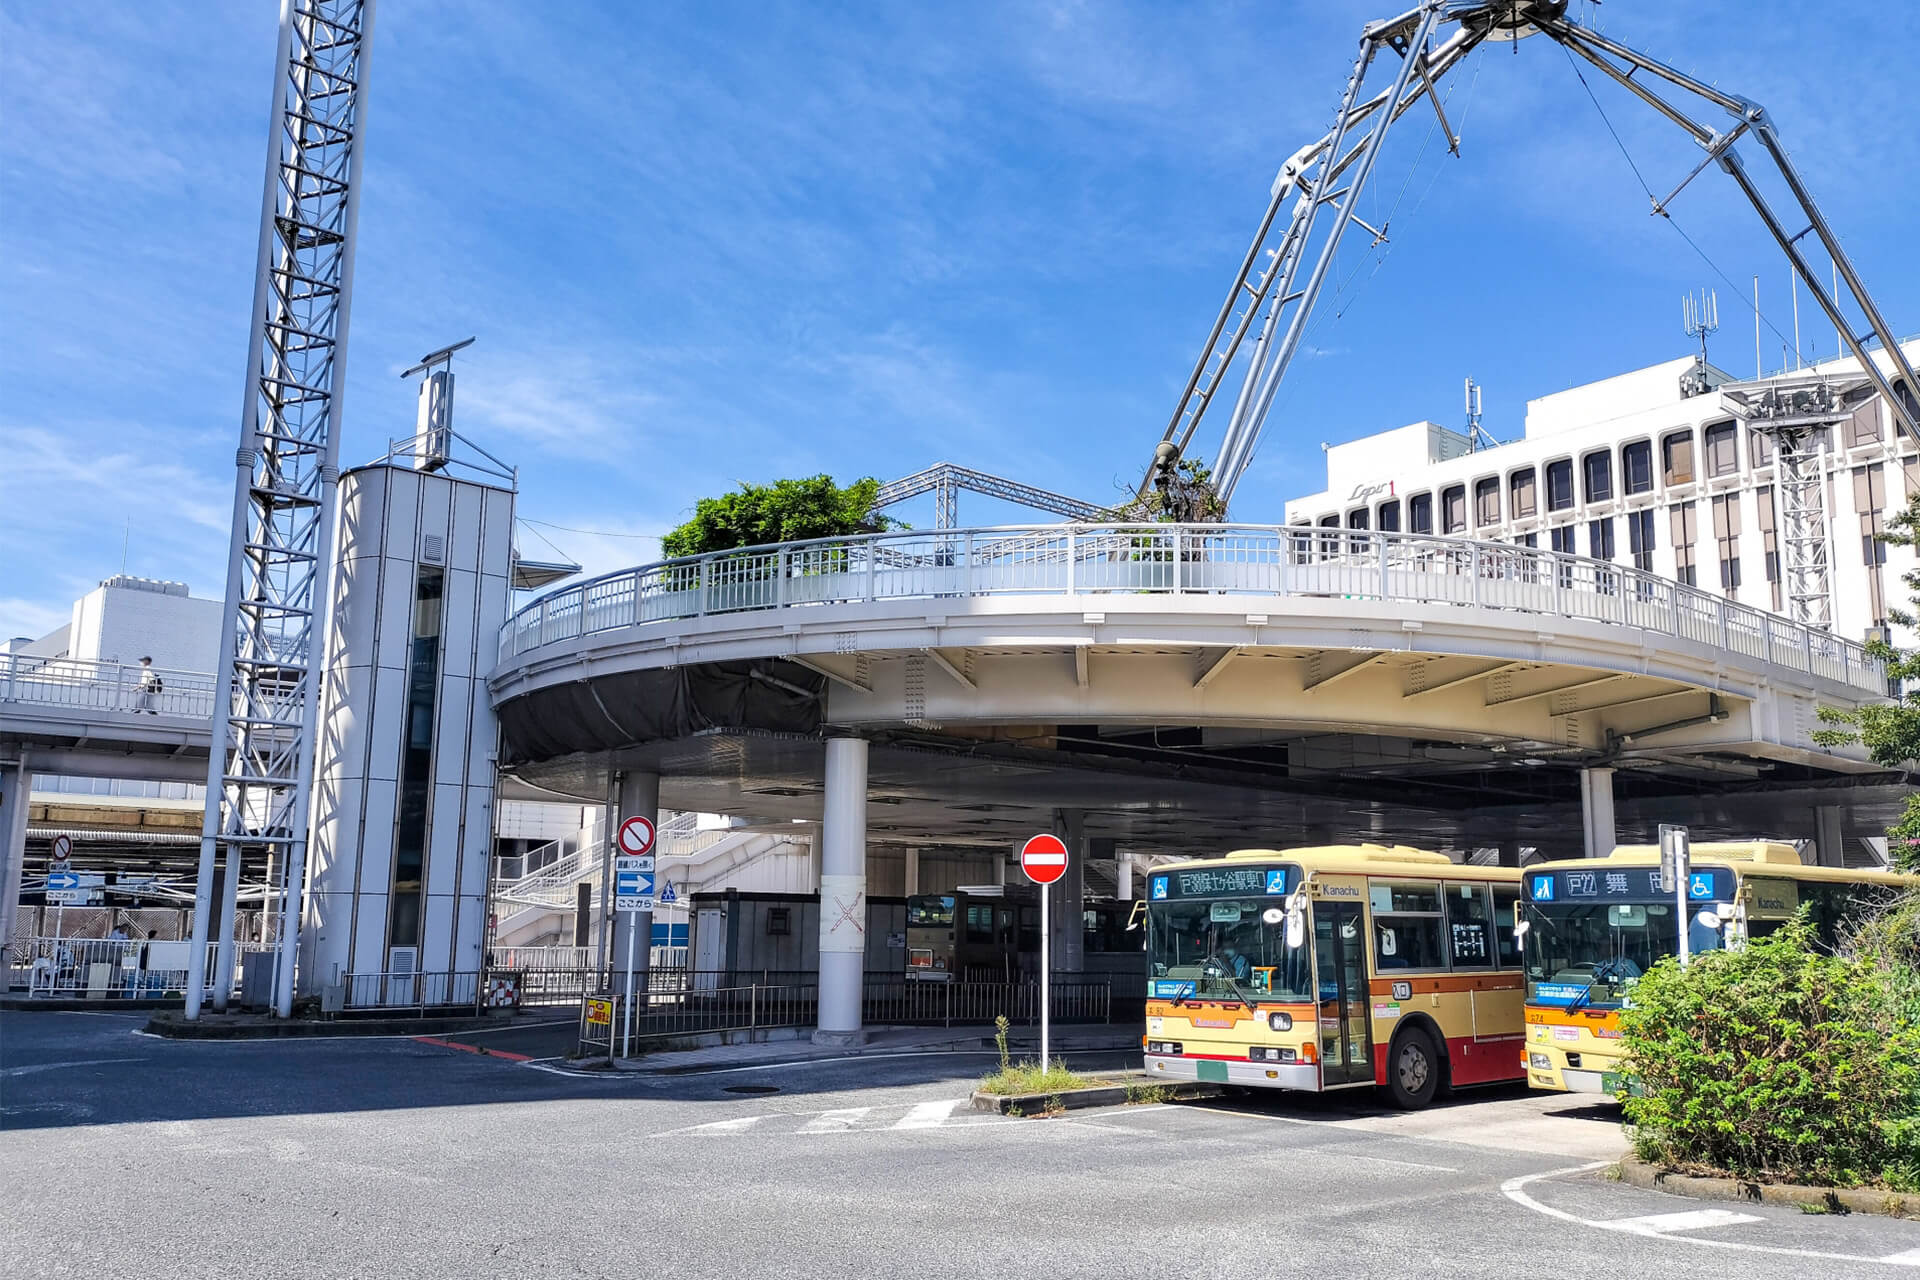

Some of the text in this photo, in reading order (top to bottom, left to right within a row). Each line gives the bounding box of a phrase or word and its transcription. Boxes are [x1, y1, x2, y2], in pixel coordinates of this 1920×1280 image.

[1322, 884, 1360, 896] Kanachu
[618, 899, 652, 908] ここから
